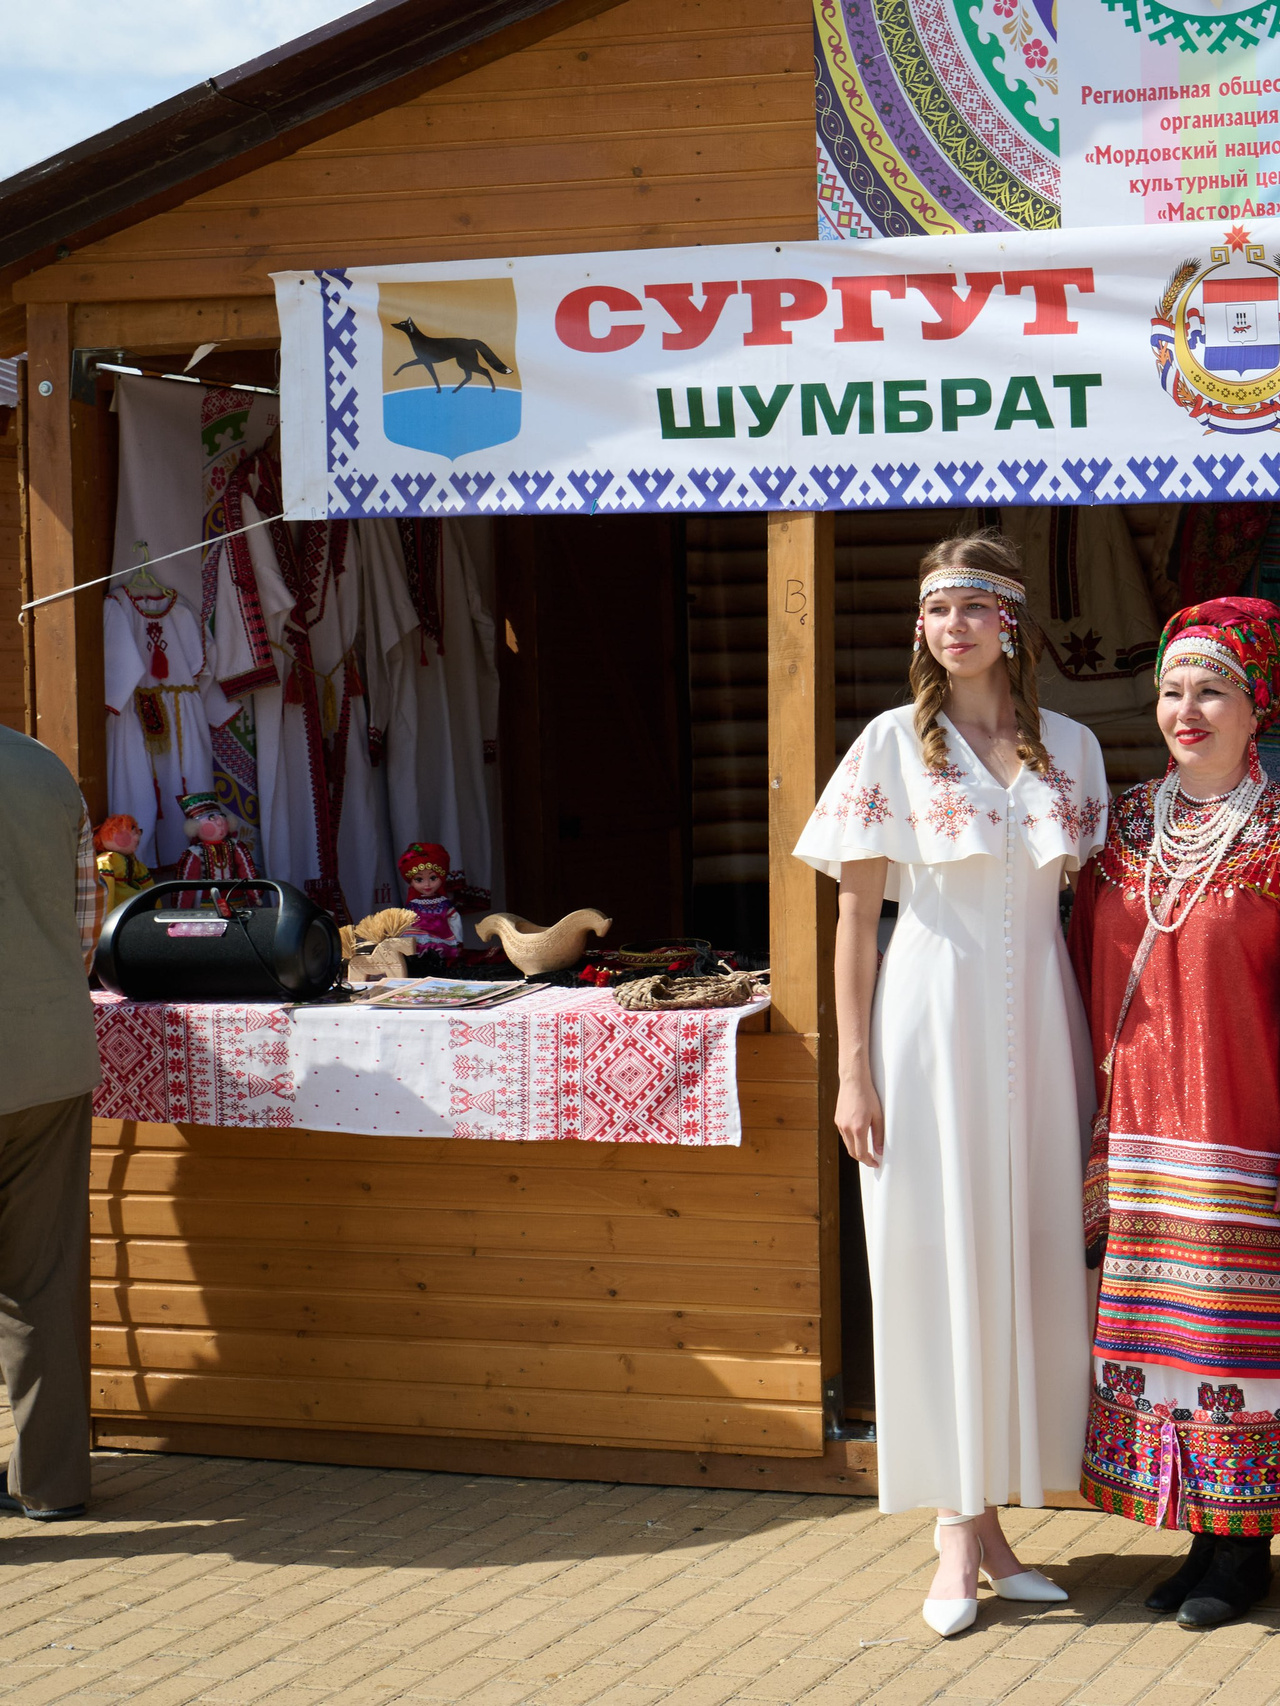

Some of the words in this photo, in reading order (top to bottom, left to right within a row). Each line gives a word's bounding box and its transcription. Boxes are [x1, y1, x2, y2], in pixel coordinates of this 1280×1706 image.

[1081, 82, 1211, 105] Региональная
[1160, 109, 1279, 134] организация
[1085, 140, 1218, 167] «Мордовский
[1129, 169, 1248, 197] культурный
[555, 268, 1095, 353] СУРГУТ
[657, 373, 1102, 439] ШУМБРАТ
